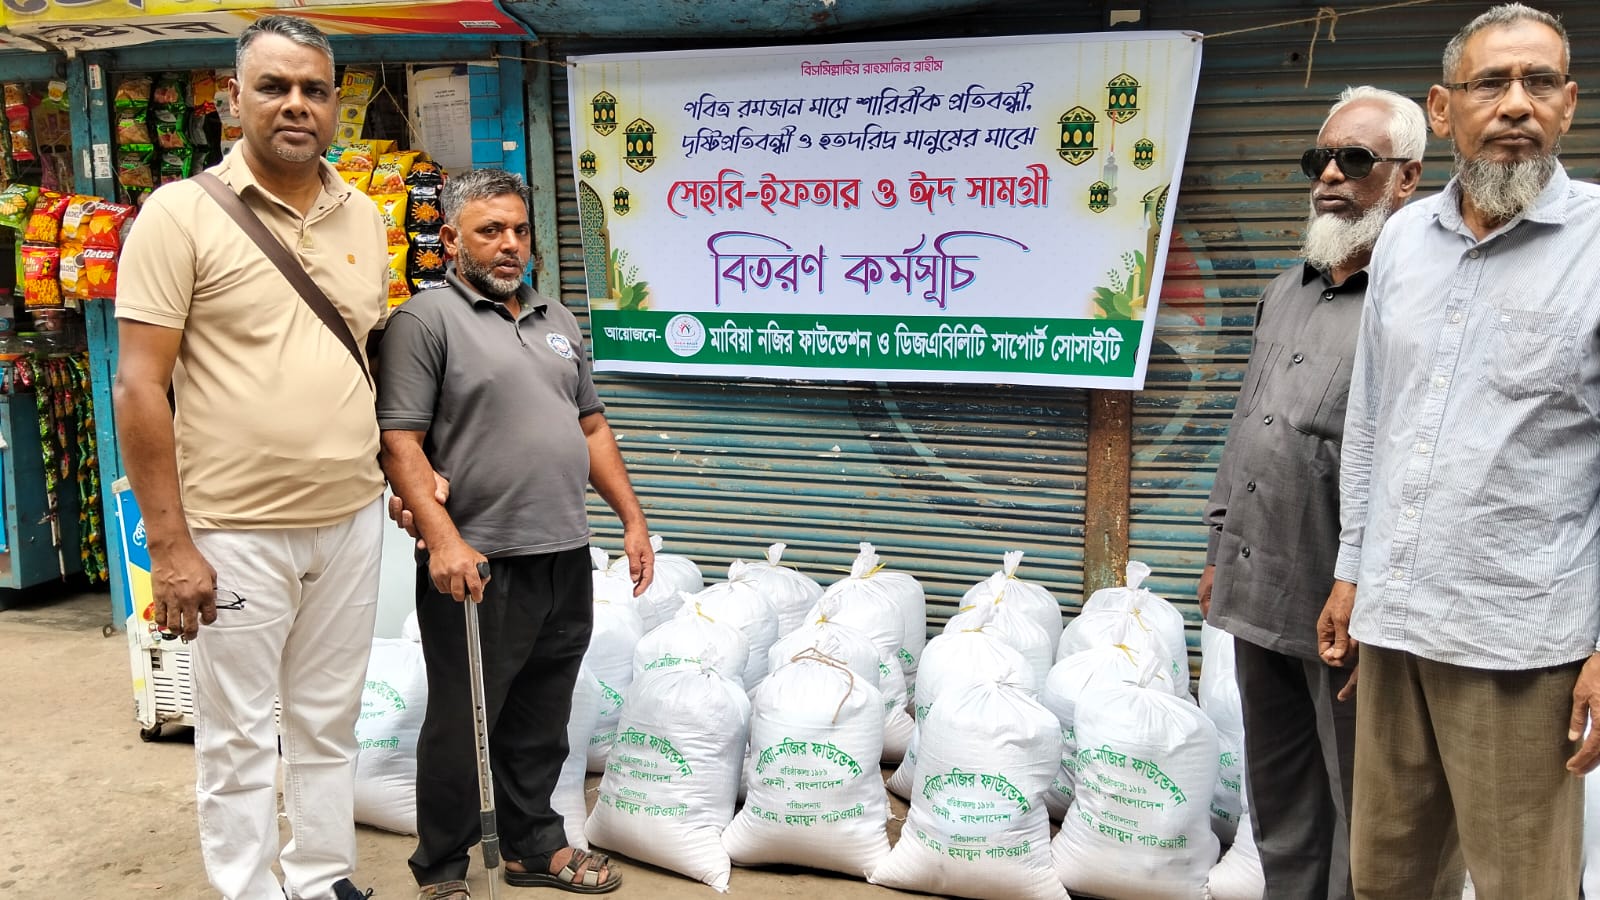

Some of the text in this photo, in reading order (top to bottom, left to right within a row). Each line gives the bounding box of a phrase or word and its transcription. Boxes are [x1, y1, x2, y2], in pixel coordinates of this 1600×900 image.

[801, 55, 943, 76] বিসমিল্লাহির রাহমানির রাহীম
[683, 93, 734, 120] পবিত্র
[738, 98, 805, 119] রমজান
[809, 96, 852, 119] মাসে
[798, 134, 813, 150] ও
[818, 123, 900, 151] হতদরিদ্র
[904, 127, 981, 154] মানুষের
[984, 126, 1040, 150] মাঝে
[667, 163, 1051, 218] সেহরি-ইফতার ও ঈদ সামগ্রী
[707, 230, 1030, 310] বিতরণ কর্মসূচি
[709, 319, 754, 354] মাবিয়া
[757, 320, 795, 355] নজির
[798, 321, 872, 358] ফাউন্ডেশন
[877, 332, 890, 355] ও
[894, 323, 988, 361] ডিজএবিলিটি
[992, 324, 1048, 362] সাপোর্ট
[1051, 327, 1124, 365] সোসাইটি
[811, 740, 863, 780] ফাউন্ডেশন
[630, 769, 672, 783] বাংলাদেশ
[794, 779, 844, 791] বাংলাদেশ
[1131, 757, 1187, 807] ফাউন্ডেশন
[980, 772, 1032, 816] ফাউন্ডেশন
[1111, 793, 1164, 812] বাংলাদেশ
[821, 803, 865, 823] পাটওয়ারী
[960, 813, 1012, 824] বাংলাদেশ
[986, 840, 1031, 859] পাটওয়ারী
